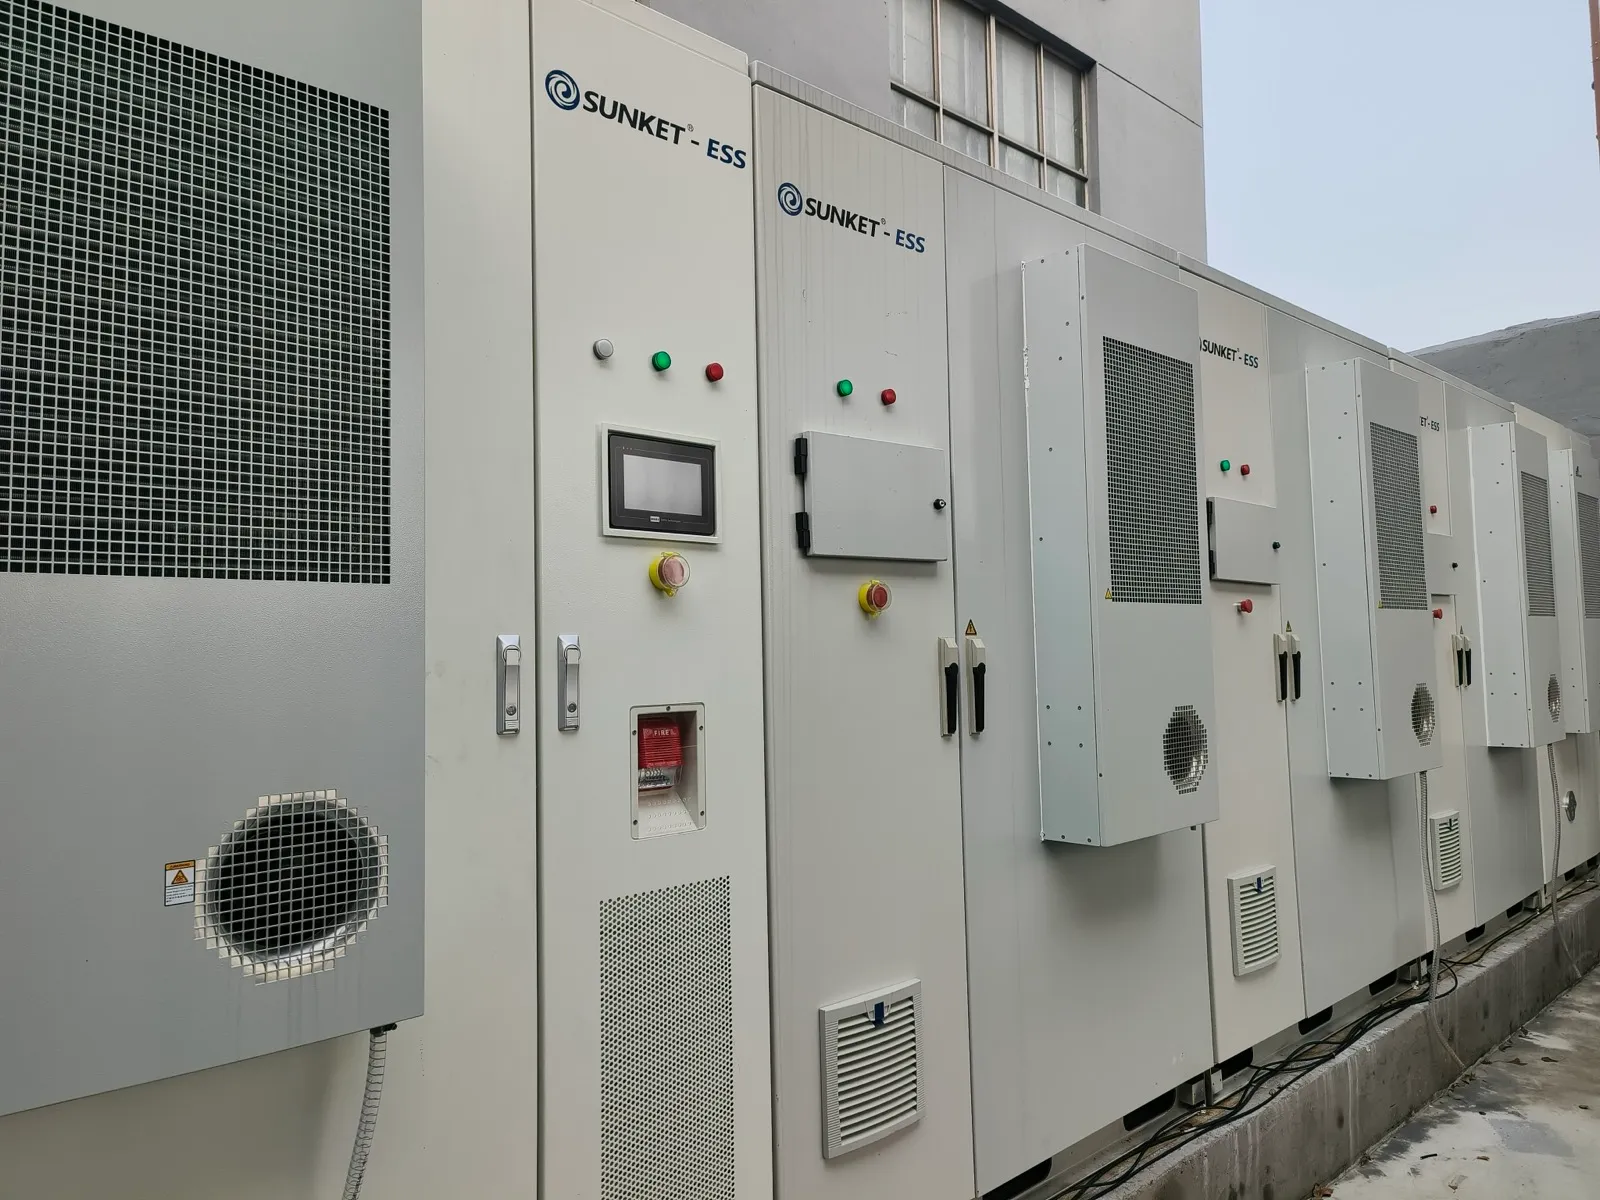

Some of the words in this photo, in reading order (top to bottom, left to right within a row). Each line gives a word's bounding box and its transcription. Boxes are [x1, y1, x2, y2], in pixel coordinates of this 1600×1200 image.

[706, 137, 747, 169] ESS
[895, 228, 926, 253] ESS
[1244, 353, 1259, 369] ESS
[653, 728, 670, 737] FIRE
